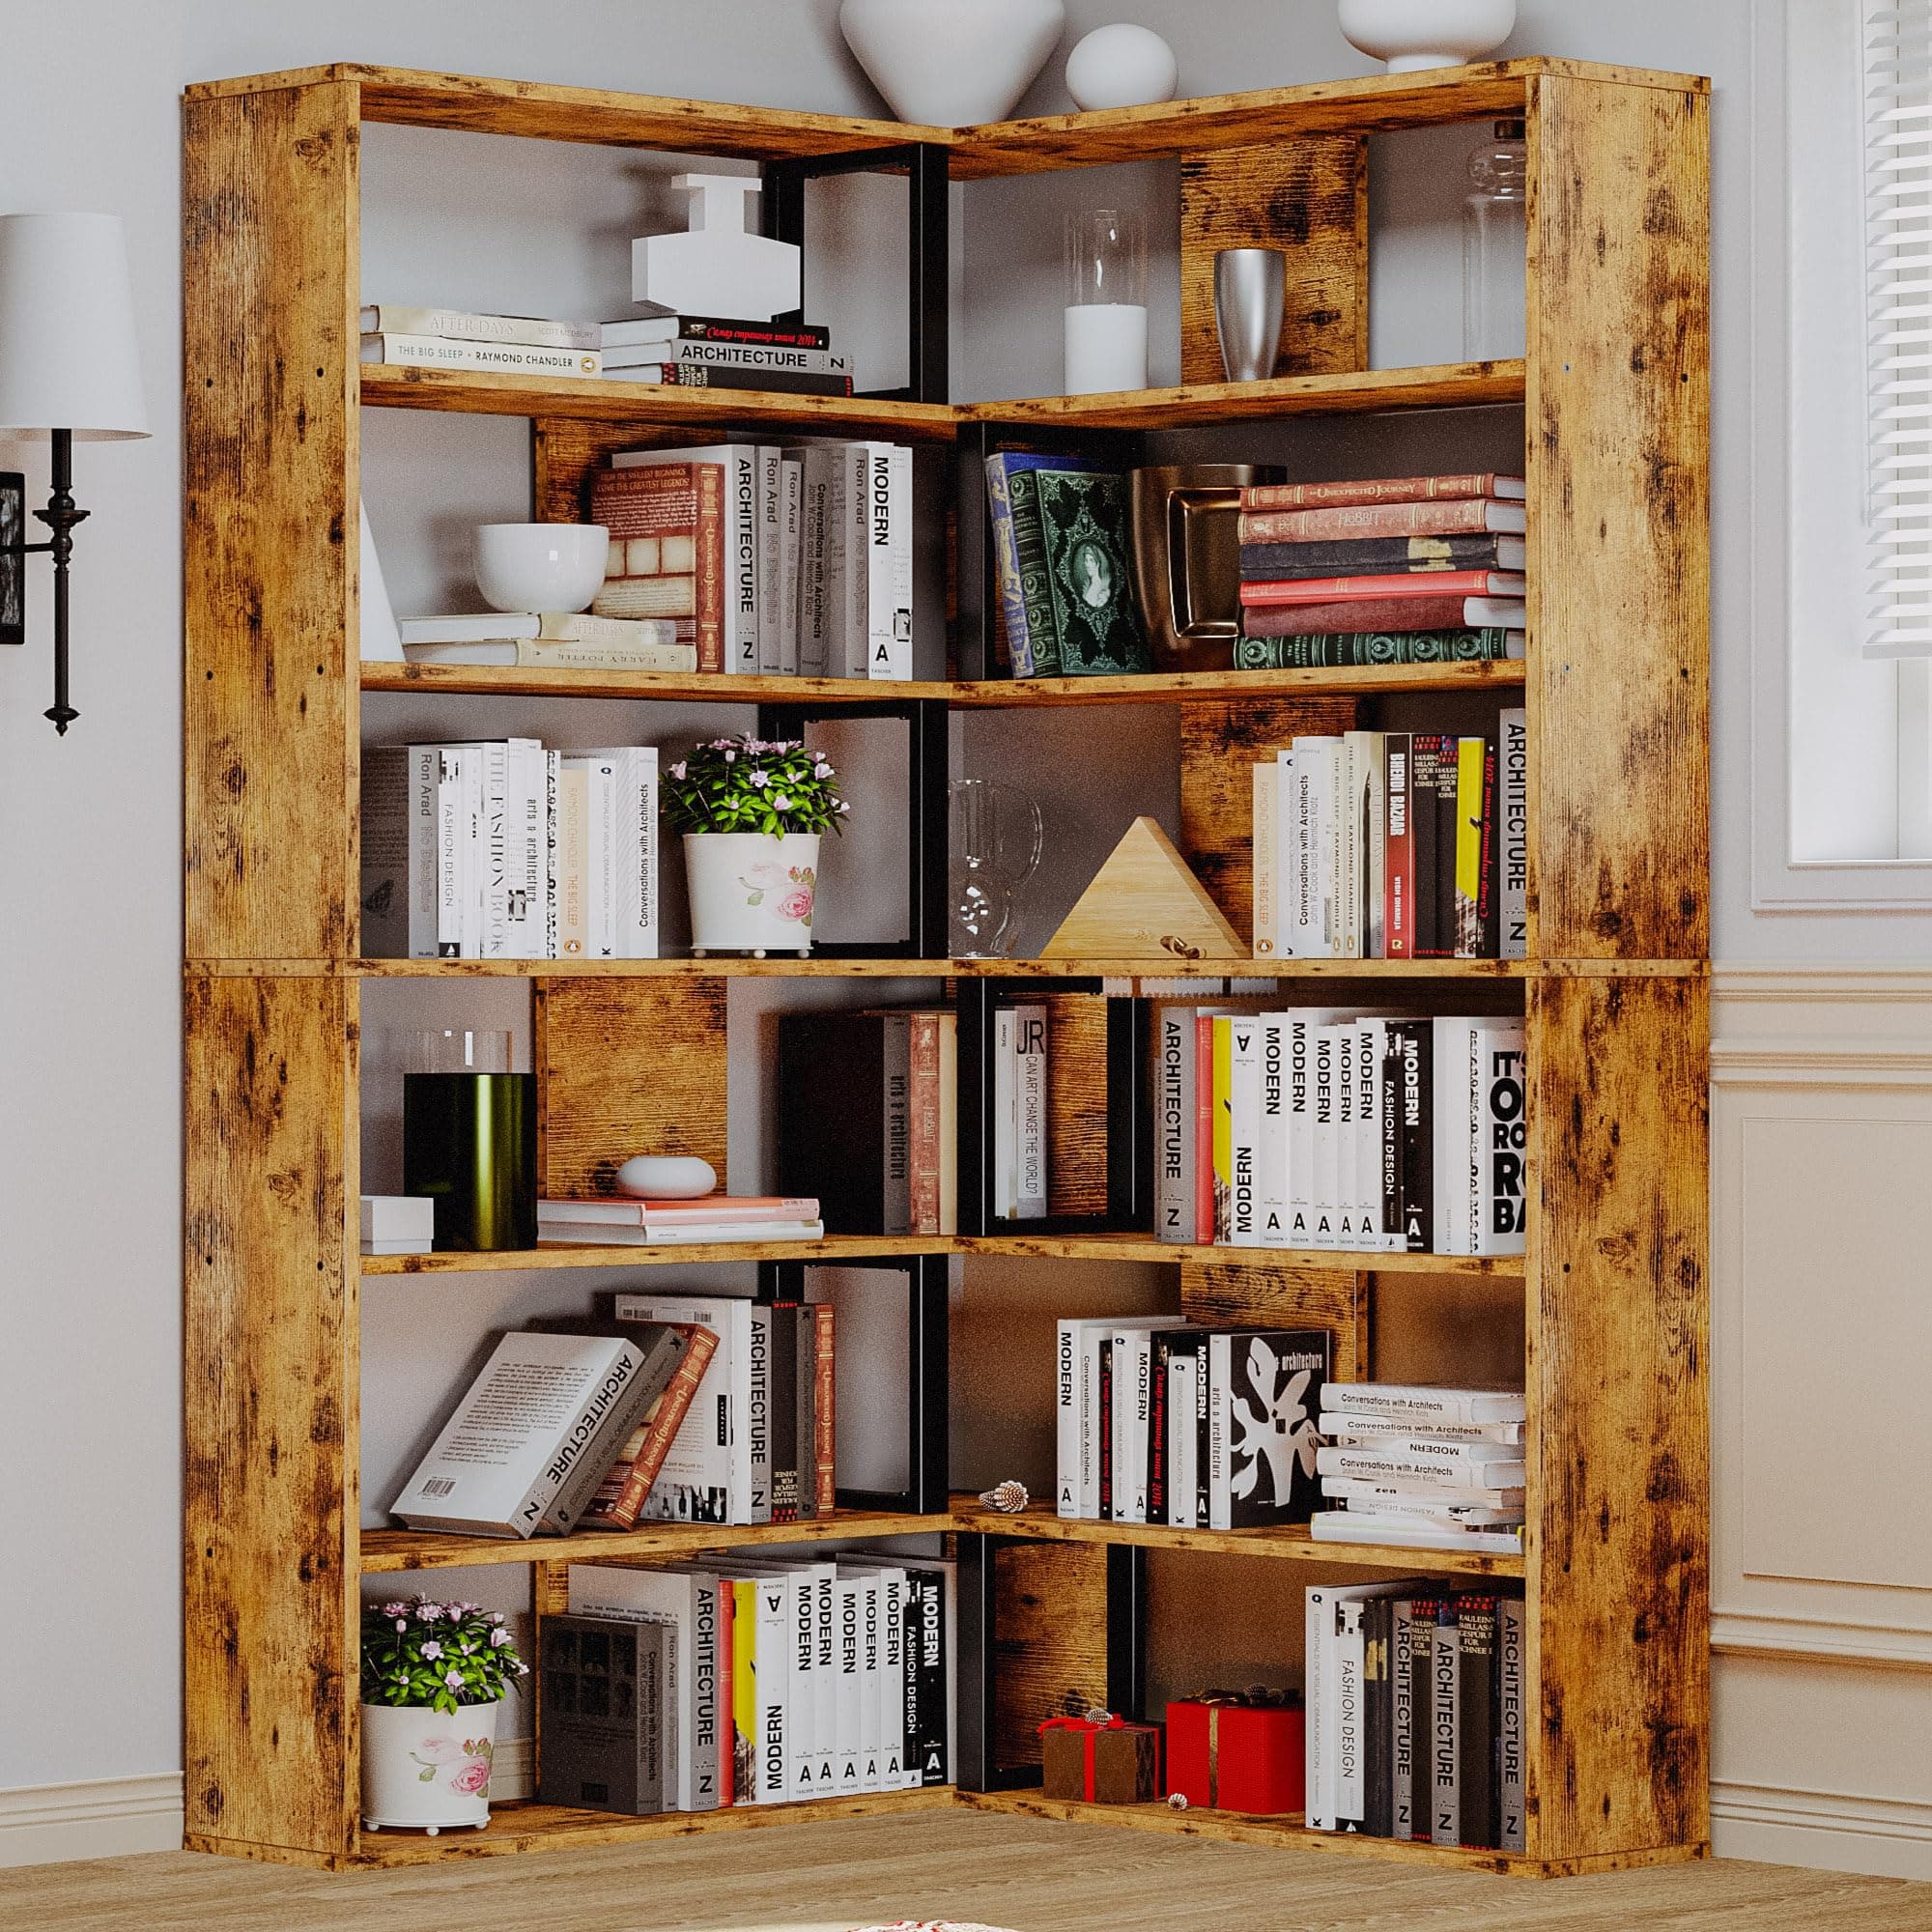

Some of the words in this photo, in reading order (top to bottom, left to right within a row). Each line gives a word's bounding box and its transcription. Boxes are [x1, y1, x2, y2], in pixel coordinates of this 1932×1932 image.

[398, 346, 415, 355] THE
[418, 347, 435, 356] BIG
[439, 348, 464, 358] SLEEP
[475, 352, 523, 364] RAYMOND
[526, 354, 574, 368] CHANDLER
[681, 345, 808, 367] ARCHITECTURE
[766, 457, 779, 486] Ron
[788, 470, 798, 498] Ron
[855, 459, 866, 487] Ron
[766, 490, 779, 524] Arad
[788, 501, 798, 533] Arad
[855, 491, 866, 525] Arad
[874, 456, 890, 546] MODERN
[738, 458, 754, 613] ARCHITECTURE
[813, 483, 826, 559] Conversations
[813, 561, 825, 583] with
[812, 585, 825, 639] Architects
[875, 644, 889, 662] A
[420, 753, 433, 782] Ron
[1389, 753, 1405, 792] BHENDI
[420, 786, 433, 816] Arad
[639, 783, 649, 833] Architects
[1298, 775, 1309, 826] Architects
[1389, 795, 1406, 837] BAZAAR
[1507, 723, 1526, 892] ARCHITECTURE
[444, 804, 455, 857] FASHION
[490, 796, 504, 887] FASHION
[639, 836, 649, 856] with
[1299, 829, 1309, 850] with
[444, 862, 455, 907] DESIGN
[526, 838, 539, 903] architecture
[567, 874, 579, 890] THE
[1260, 872, 1269, 888] THE
[1299, 852, 1309, 926] Conversations
[639, 858, 649, 927] Conversations
[1260, 889, 1269, 902] BIG
[1260, 903, 1269, 926] SLEEP
[1016, 1019, 1045, 1055] JR
[1236, 1035, 1251, 1052] A
[1025, 1056, 1038, 1074] CAN
[1265, 1027, 1281, 1115] MODERN
[1293, 1022, 1305, 1113] MODERN
[1318, 1040, 1331, 1123] MODERN
[1341, 1038, 1351, 1122] MODERN
[1360, 1033, 1374, 1120] MODERN
[1404, 1039, 1419, 1126] MODERN
[1025, 1076, 1038, 1094] ART
[1166, 1021, 1181, 1179] ARCHITECTURE
[1025, 1096, 1038, 1134] CHANGE
[1384, 1080, 1395, 1141] FASHION
[890, 1114, 905, 1179] architecture
[1025, 1136, 1038, 1153] THE
[1025, 1155, 1038, 1194] WORLD?
[1385, 1145, 1395, 1195] DESIGN
[1236, 1147, 1252, 1233] MODERN
[1266, 1212, 1281, 1230] A
[1293, 1212, 1306, 1230] A
[1318, 1216, 1331, 1233] A
[1341, 1216, 1351, 1233] A
[1361, 1216, 1374, 1234] A
[1407, 1218, 1421, 1236] A
[1061, 1331, 1072, 1406] MODERN
[1282, 1352, 1322, 1371] architecture
[751, 1321, 766, 1464] ARCHITECTURE
[1138, 1352, 1149, 1421] MODERN
[1197, 1345, 1207, 1420] MODERN
[1341, 1393, 1390, 1407] Conversations
[1392, 1398, 1407, 1408] with
[1407, 1399, 1443, 1411] Architects
[546, 1353, 634, 1485] ARCHITECTURE
[1347, 1421, 1412, 1432] Conversations
[1414, 1424, 1434, 1434] with
[1436, 1425, 1483, 1435] Architects
[1212, 1422, 1222, 1480] architecture
[1340, 1457, 1394, 1471] Conversations
[1396, 1463, 1412, 1473] with
[1414, 1464, 1454, 1476] Architects
[1409, 1443, 1461, 1456] MODERN
[1062, 1488, 1072, 1502] A
[1136, 1495, 1145, 1509] A
[1197, 1497, 1207, 1514] A
[767, 1596, 781, 1612] A
[819, 1578, 832, 1666] MODERN
[798, 1585, 811, 1671] MODERN
[843, 1593, 856, 1674] MODERN
[866, 1589, 876, 1670] MODERN
[887, 1582, 899, 1666] MODERN
[923, 1585, 939, 1667] MODERN
[668, 1635, 676, 1659] Ron
[906, 1626, 917, 1682] FASHION
[648, 1651, 657, 1715] Conversations
[668, 1662, 676, 1689] Arad
[697, 1588, 714, 1747] ARCHITECTURE
[906, 1686, 917, 1734] DESIGN
[1342, 1660, 1354, 1721] FASHION
[1397, 1617, 1410, 1776] ARCHITECTURE
[1505, 1617, 1519, 1785] ARCHITECTURE
[648, 1717, 657, 1735] with
[1436, 1641, 1454, 1787] ARCHITECTURE
[767, 1705, 782, 1789] MODERN
[888, 1756, 899, 1774] A
[926, 1752, 941, 1771] A
[1342, 1726, 1354, 1778] DESIGN
[799, 1765, 811, 1782] A
[820, 1762, 832, 1779] A
[843, 1762, 856, 1778] A
[867, 1759, 876, 1776] A
